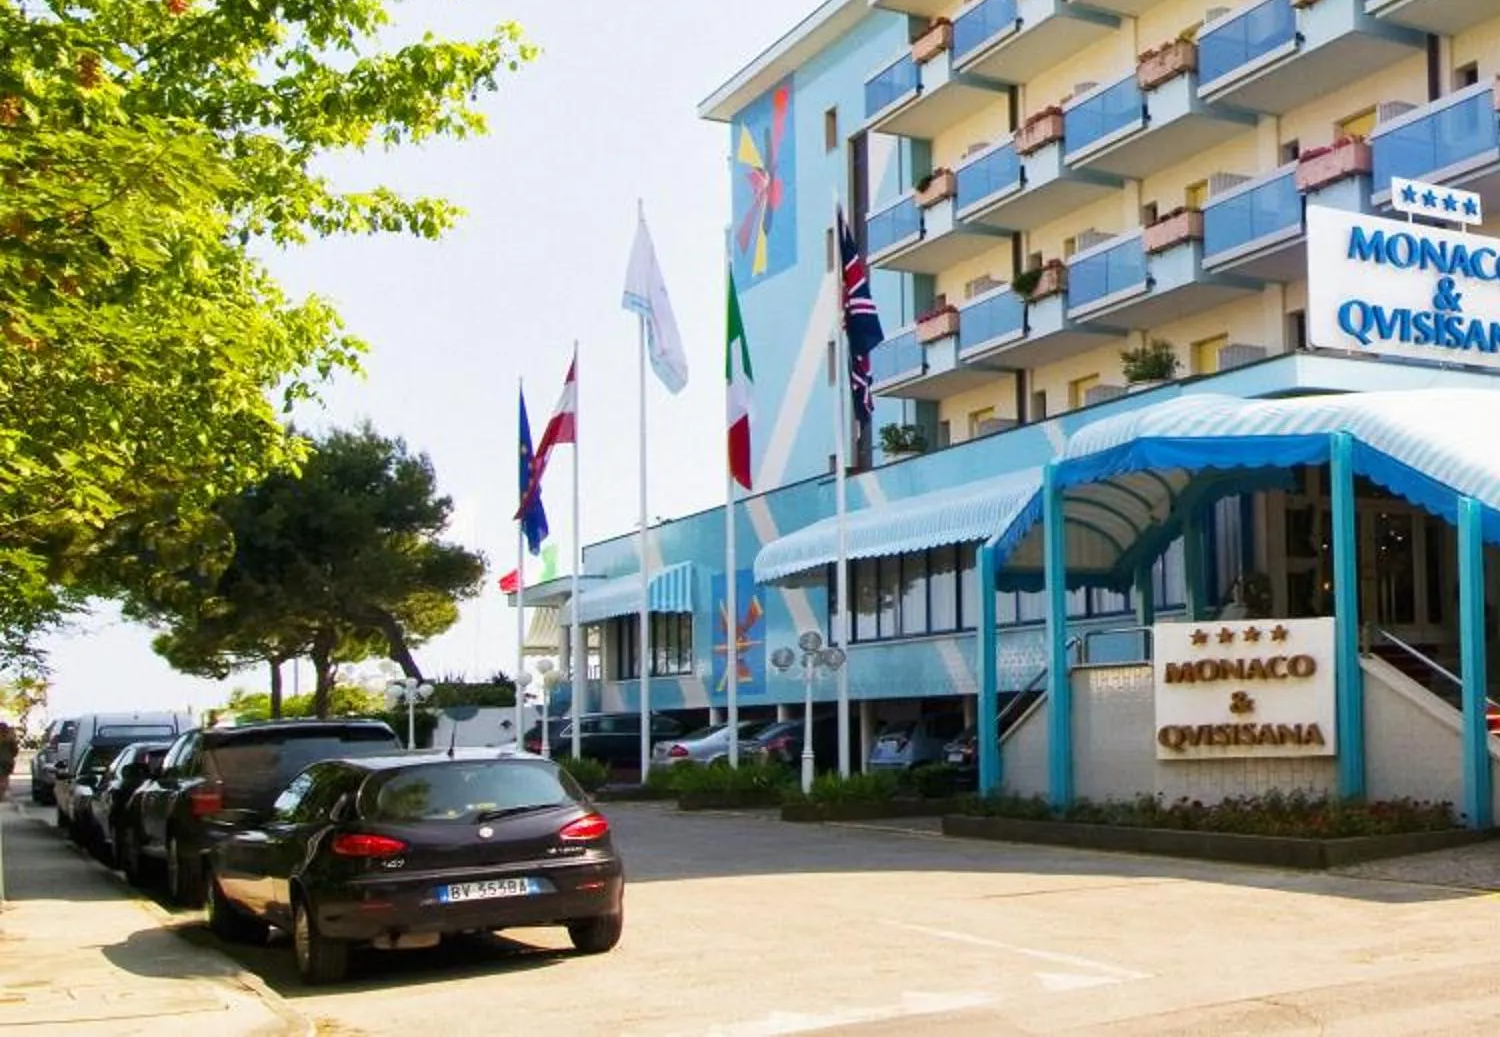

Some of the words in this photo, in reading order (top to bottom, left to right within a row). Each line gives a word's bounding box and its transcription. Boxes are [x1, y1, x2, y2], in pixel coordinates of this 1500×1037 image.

[1432, 276, 1462, 312] &
[1164, 654, 1317, 684] MONACO
[1229, 690, 1256, 714] &
[1158, 722, 1325, 753] QVISISANA
